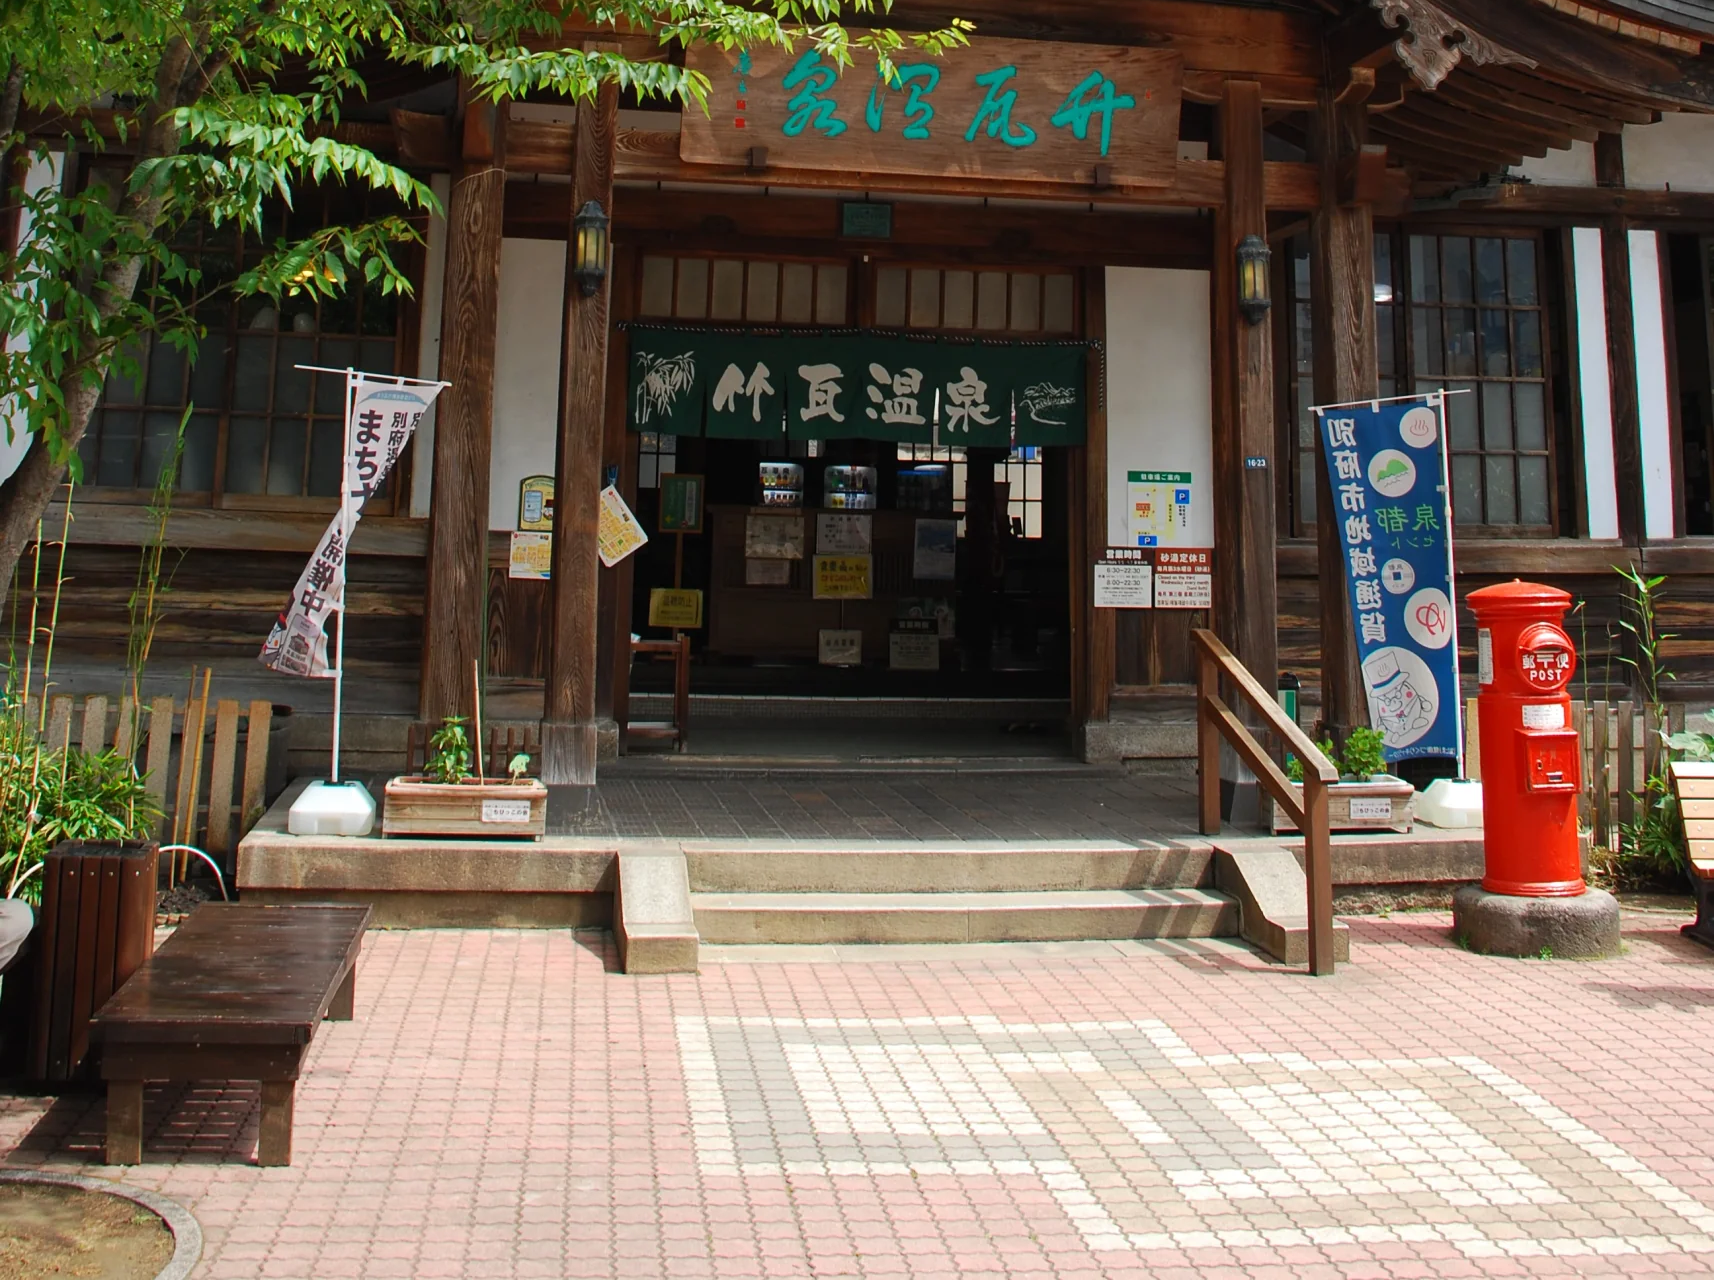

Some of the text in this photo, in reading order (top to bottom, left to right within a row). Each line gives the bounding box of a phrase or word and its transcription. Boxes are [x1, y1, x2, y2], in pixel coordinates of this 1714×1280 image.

[712, 361, 1001, 432] 竹瓦温泉
[1530, 670, 1563, 681] POST
